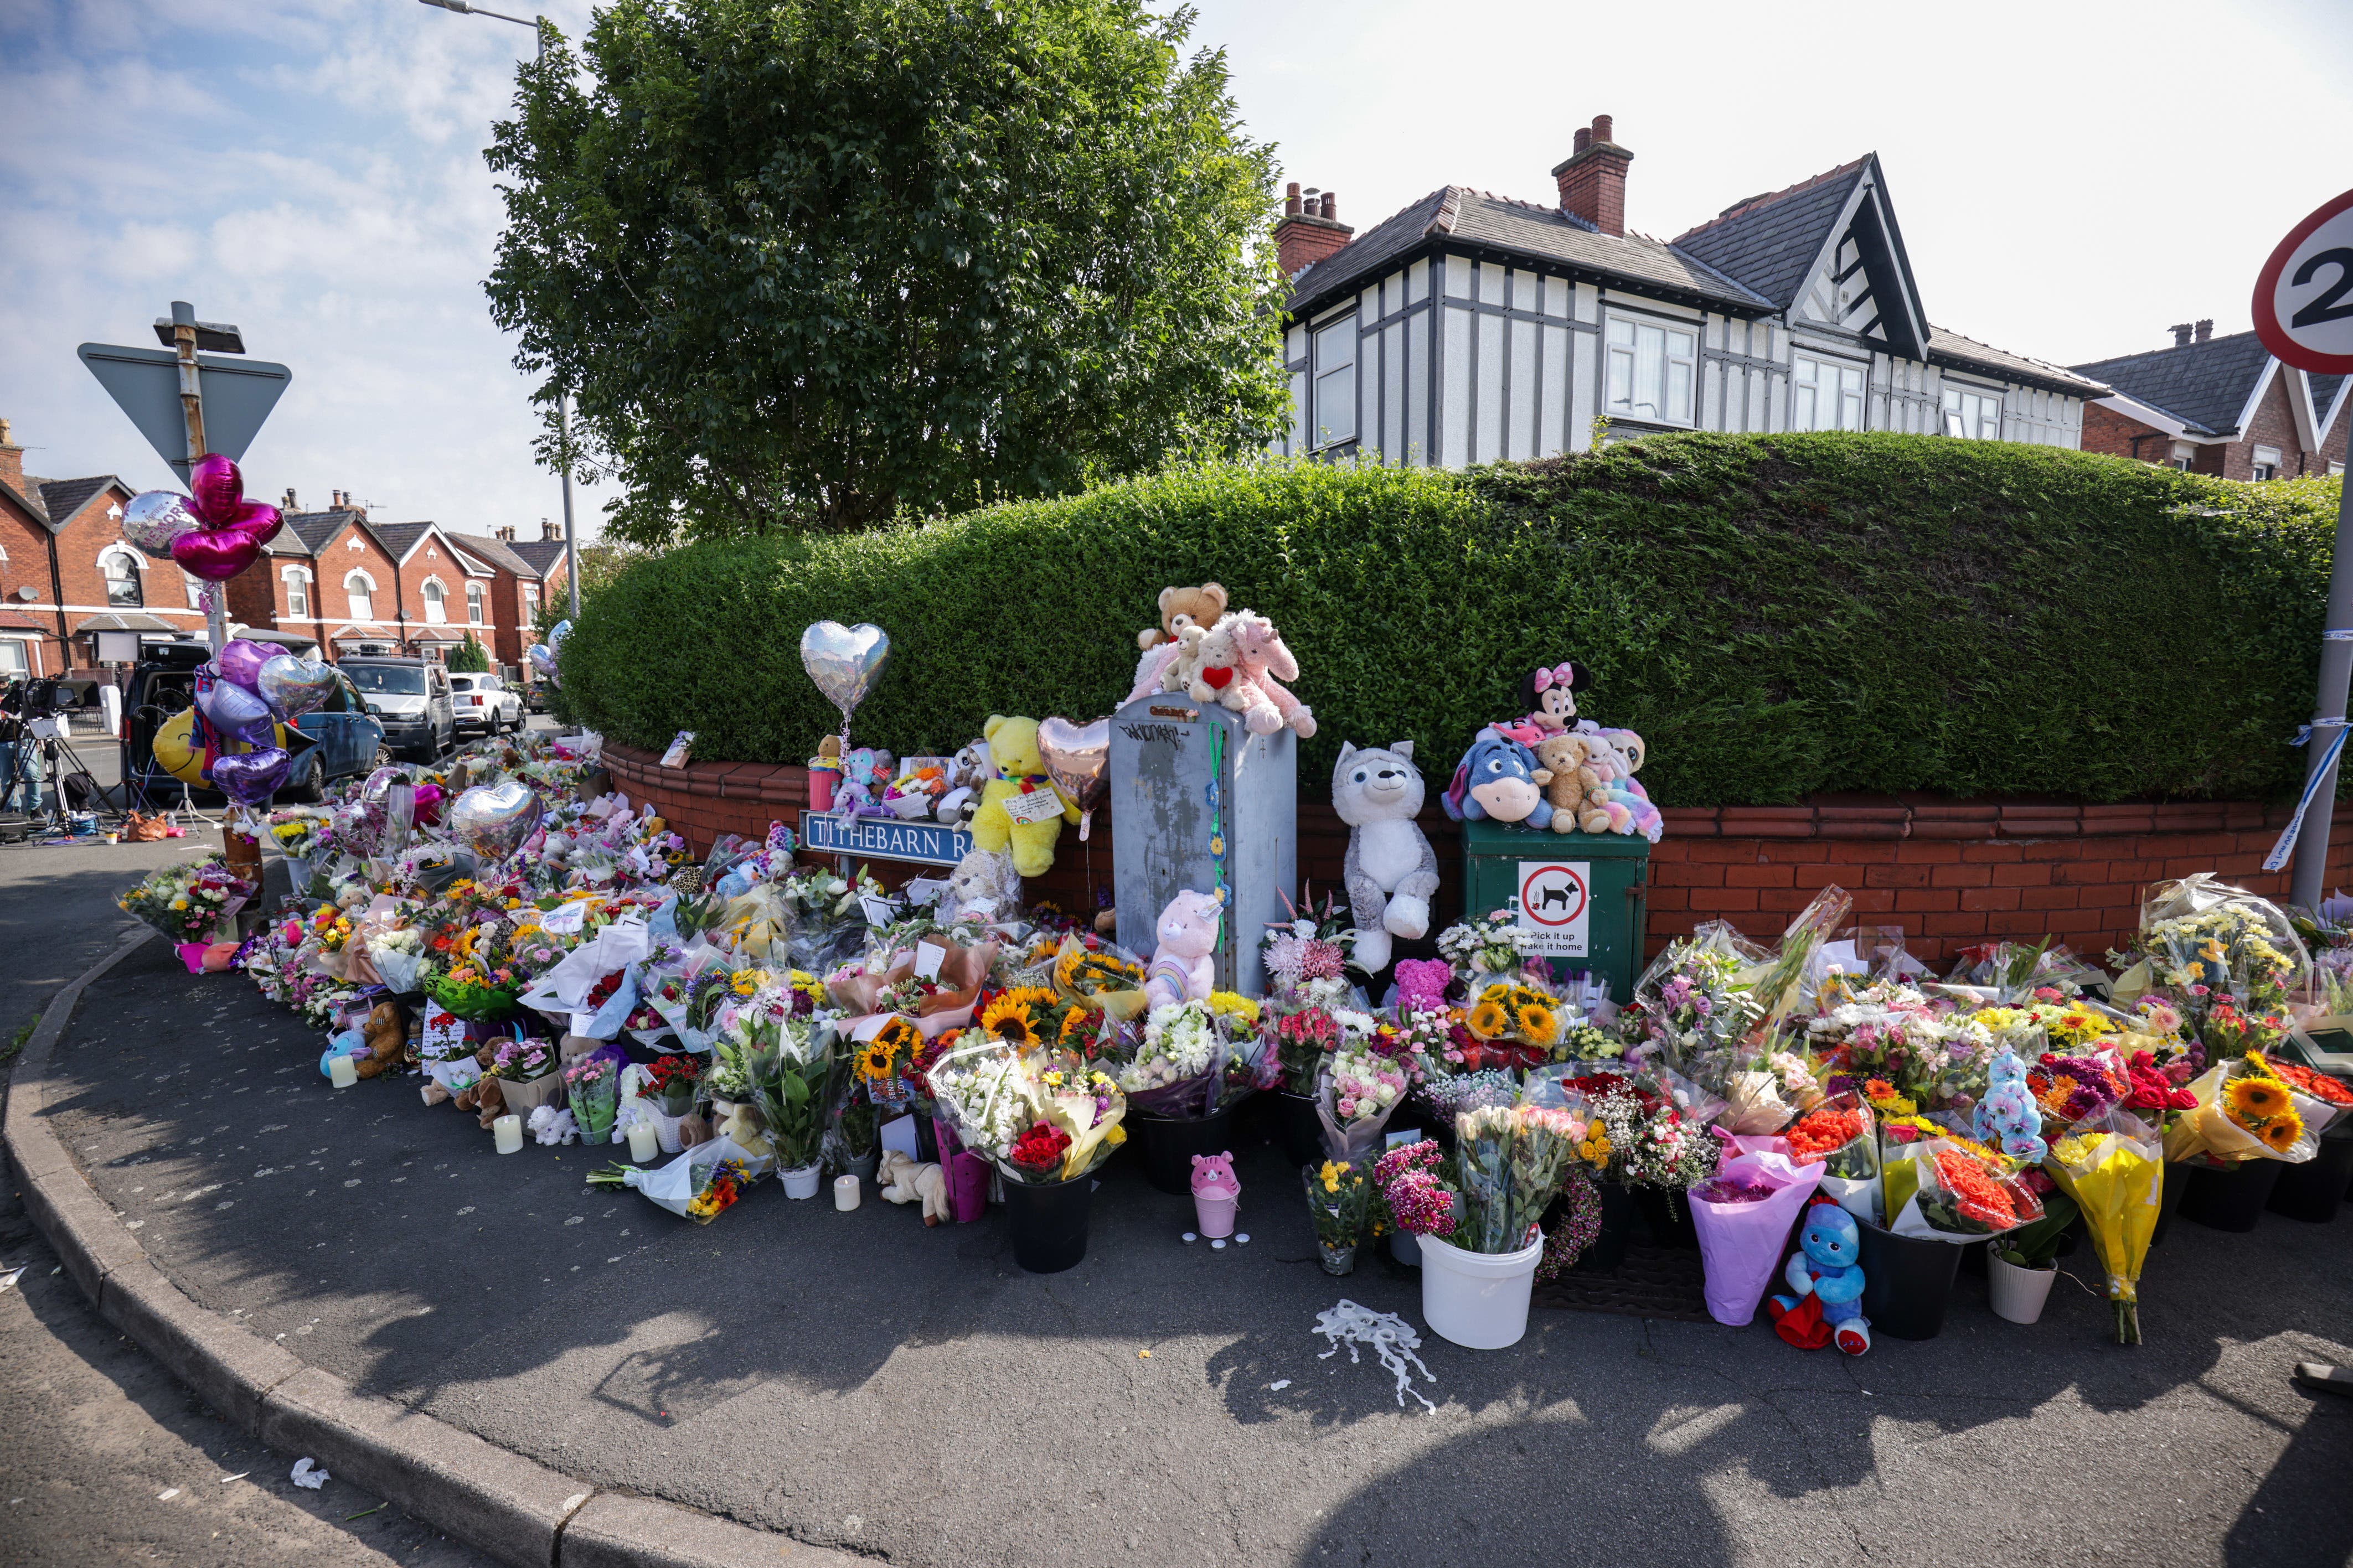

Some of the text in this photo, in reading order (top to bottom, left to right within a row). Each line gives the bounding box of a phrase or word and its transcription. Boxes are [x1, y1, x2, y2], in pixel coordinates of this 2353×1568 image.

[141, 501, 188, 549] MEMORY
[814, 820, 940, 855] TITHEBARN
[1531, 932, 1550, 940] Pick
[1556, 943, 1582, 951] home
[897, 1074, 905, 1094] LOVE
[2310, 1093, 2326, 1102] CARE
[2045, 1108, 2060, 1117] HAND
[1943, 1173, 1951, 1187] WITH
[1950, 1186, 1962, 1200] CARE
[1969, 1202, 1986, 1212] HAND
[1986, 1209, 2006, 1218] PICKED
